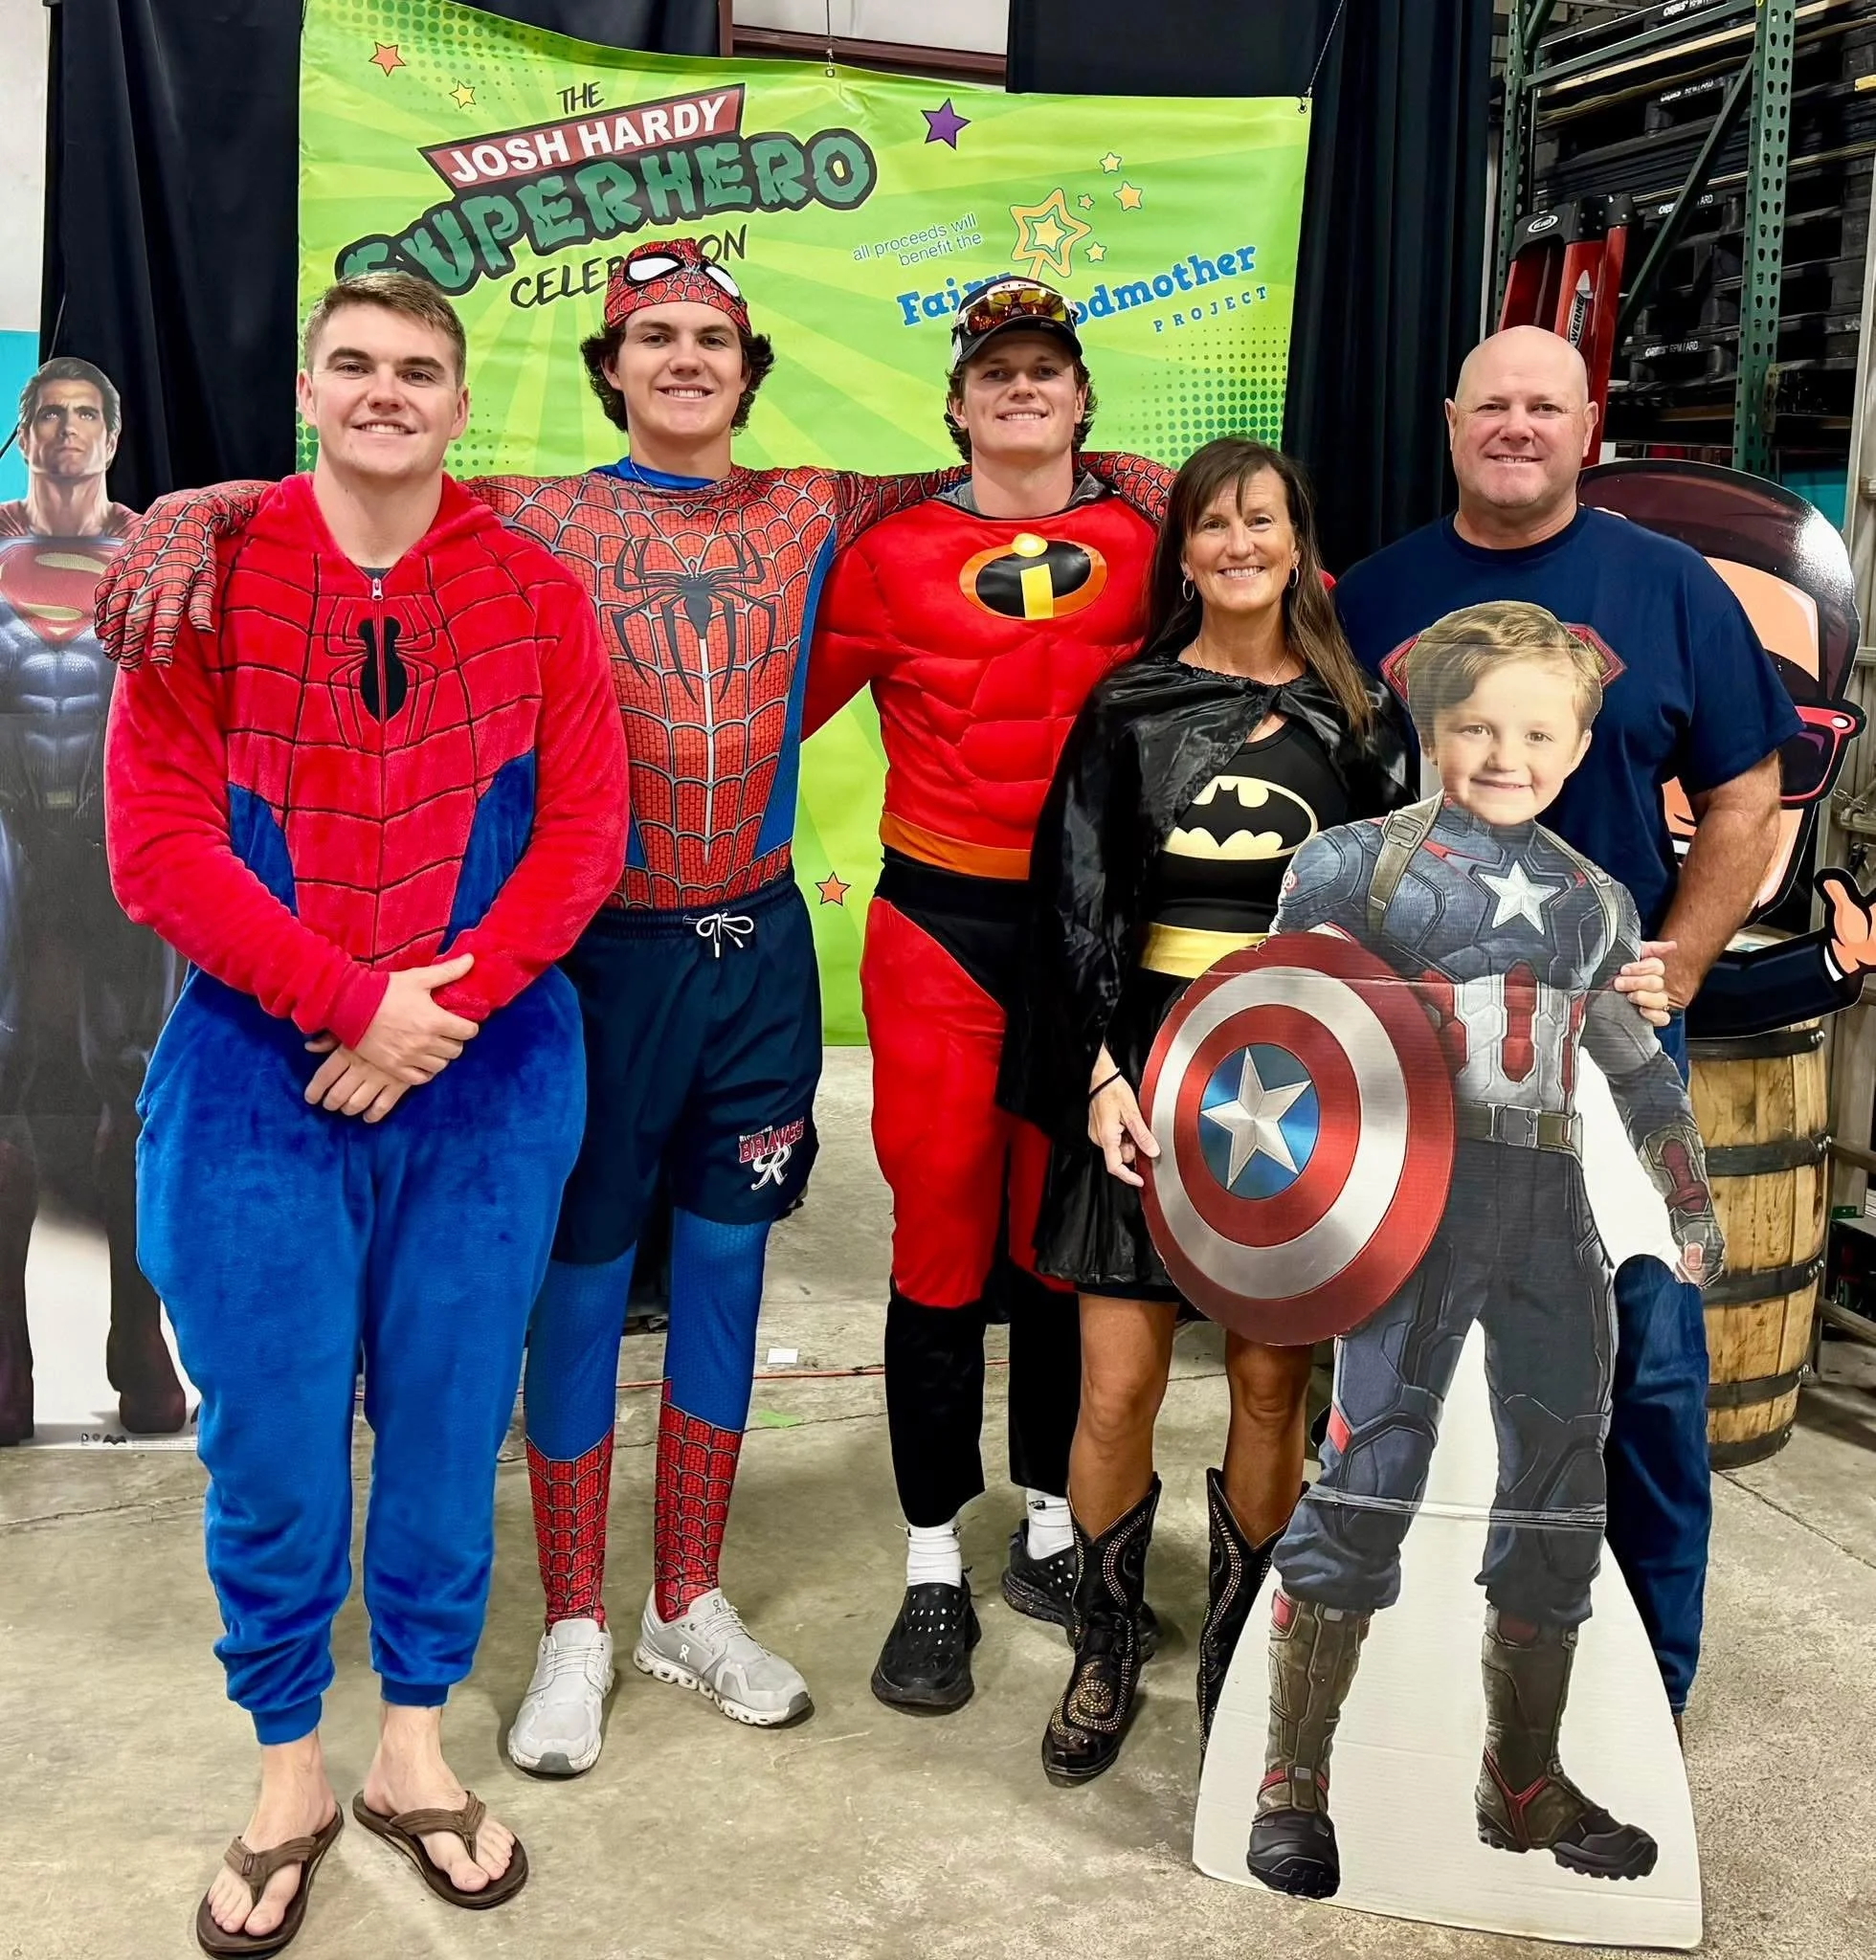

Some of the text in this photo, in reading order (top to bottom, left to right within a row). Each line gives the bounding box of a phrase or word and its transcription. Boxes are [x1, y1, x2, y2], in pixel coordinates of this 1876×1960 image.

[556, 81, 605, 115] THE
[451, 95, 727, 182] JOSH HARDY
[853, 212, 976, 261] all proceeds will
[899, 234, 981, 266] benefit the
[896, 245, 1256, 325] Fai odmother
[1152, 286, 1266, 332] PROJECT
[1570, 293, 1586, 343] WERNE
